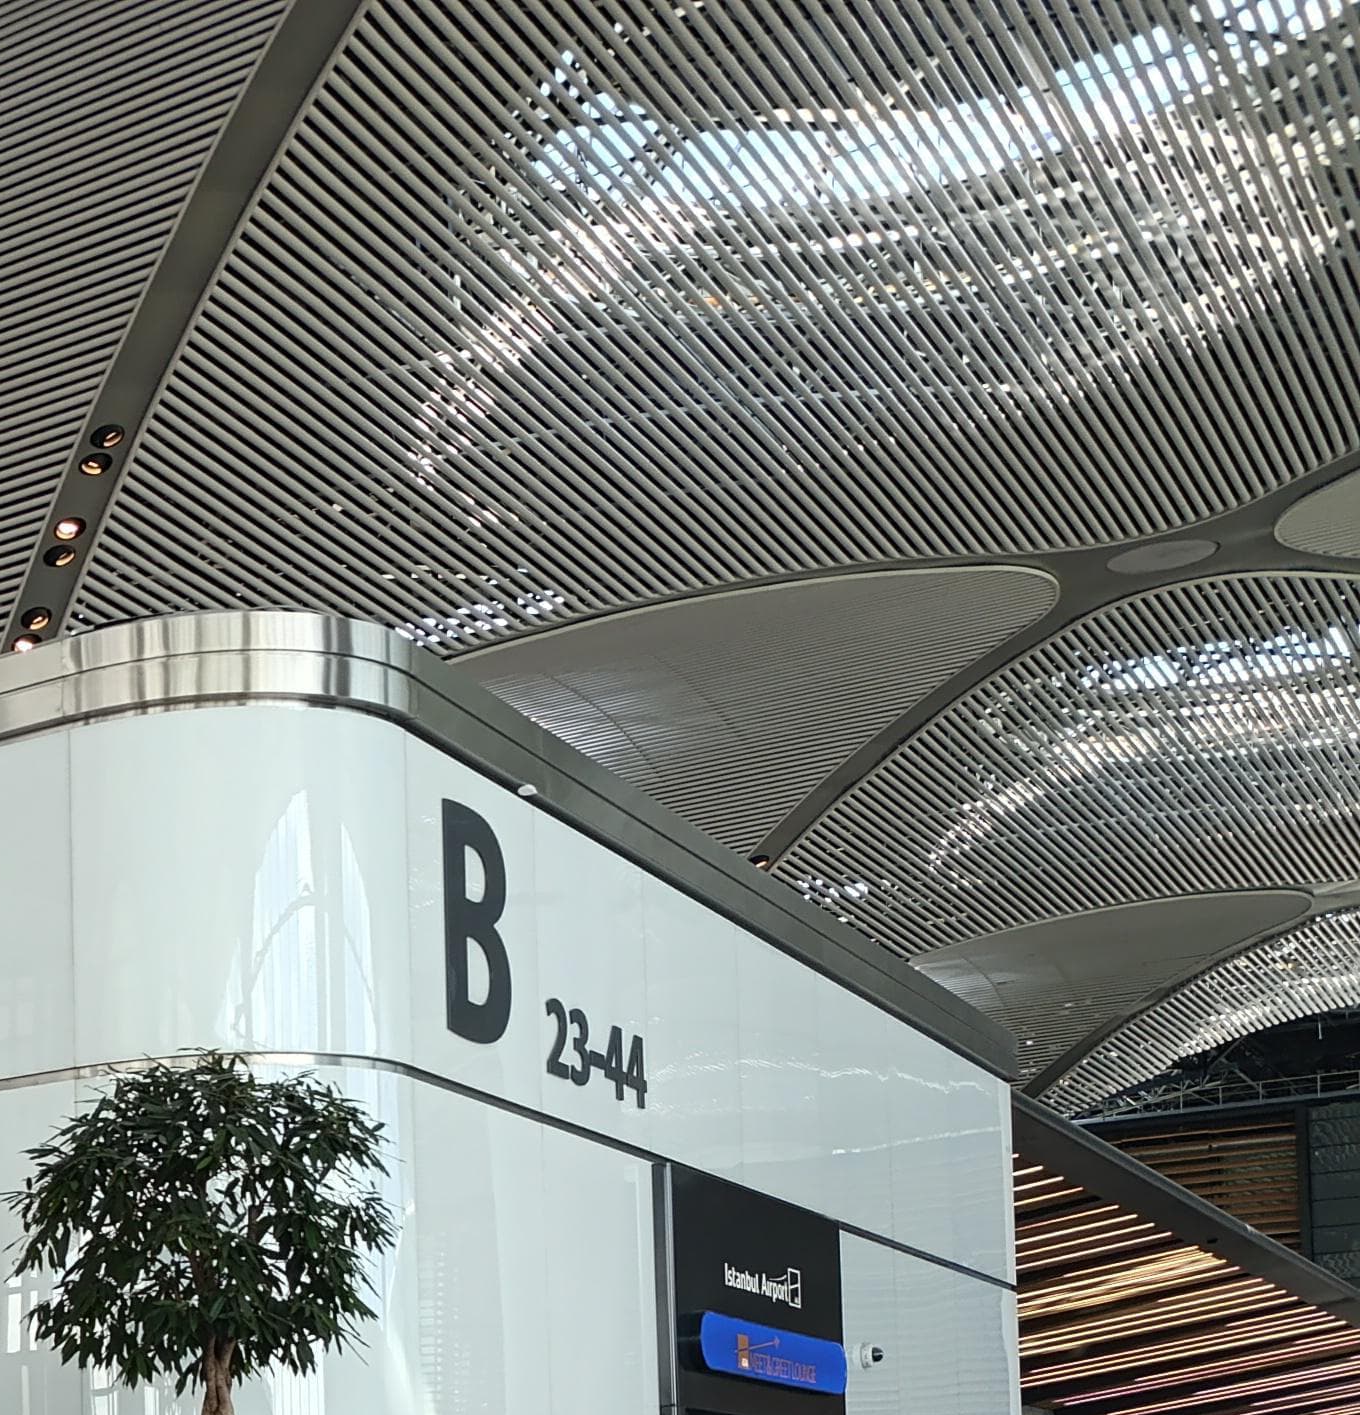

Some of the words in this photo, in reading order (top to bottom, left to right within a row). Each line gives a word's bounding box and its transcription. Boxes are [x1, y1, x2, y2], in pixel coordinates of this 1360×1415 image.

[441, 798, 512, 1045] B
[545, 998, 648, 1109] 23-44
[724, 1262, 759, 1294] Istanbul
[761, 1273, 789, 1302] Airport
